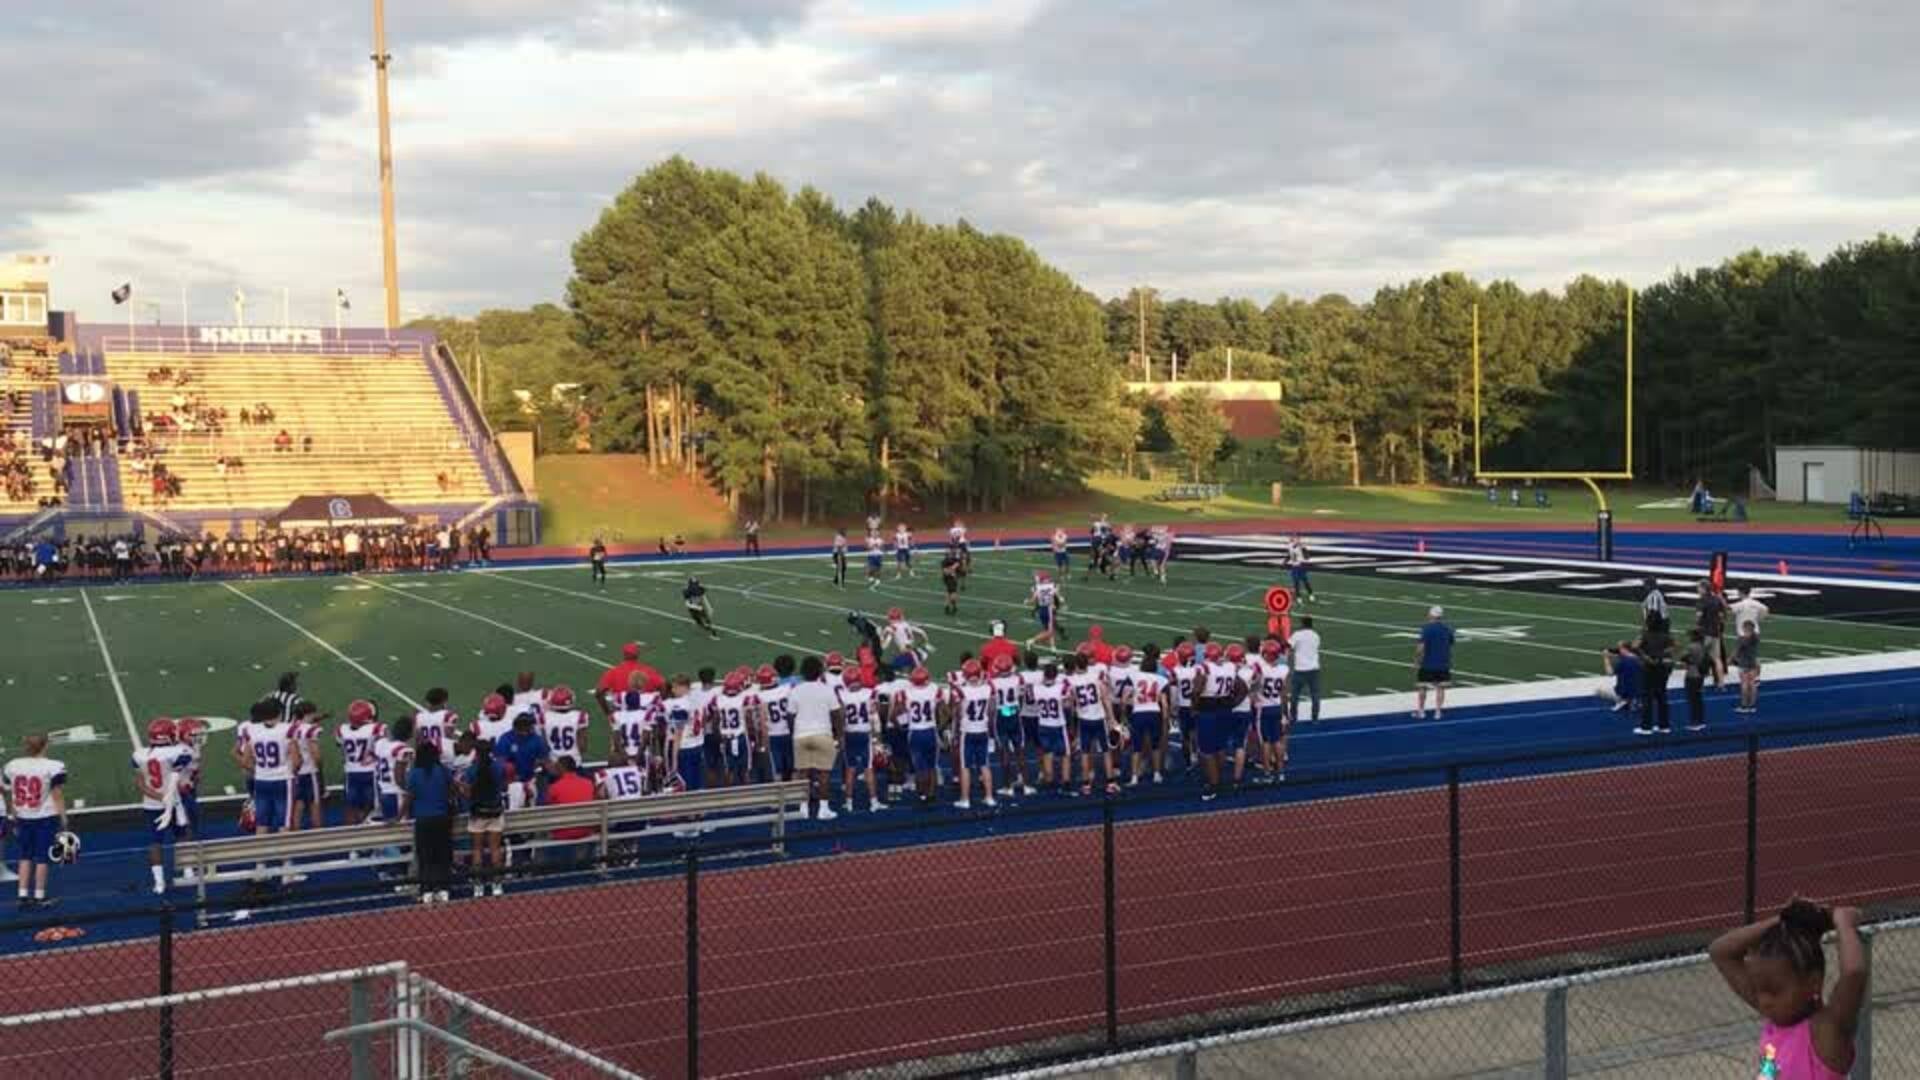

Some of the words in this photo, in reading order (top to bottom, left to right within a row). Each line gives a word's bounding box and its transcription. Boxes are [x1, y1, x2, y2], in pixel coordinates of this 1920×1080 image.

[1076, 684, 1097, 706] 53
[1137, 679, 1159, 704] 34
[1263, 677, 1284, 698] 59
[721, 707, 740, 729] 13
[846, 703, 869, 725] 24
[911, 702, 933, 723] 34
[966, 699, 987, 721] 47
[1037, 698, 1059, 719] 39
[550, 726, 575, 750] 46
[255, 742, 280, 768] 99
[344, 738, 368, 762] 27
[148, 758, 162, 788] 9
[613, 770, 639, 795] 15
[13, 775, 42, 807] 69
